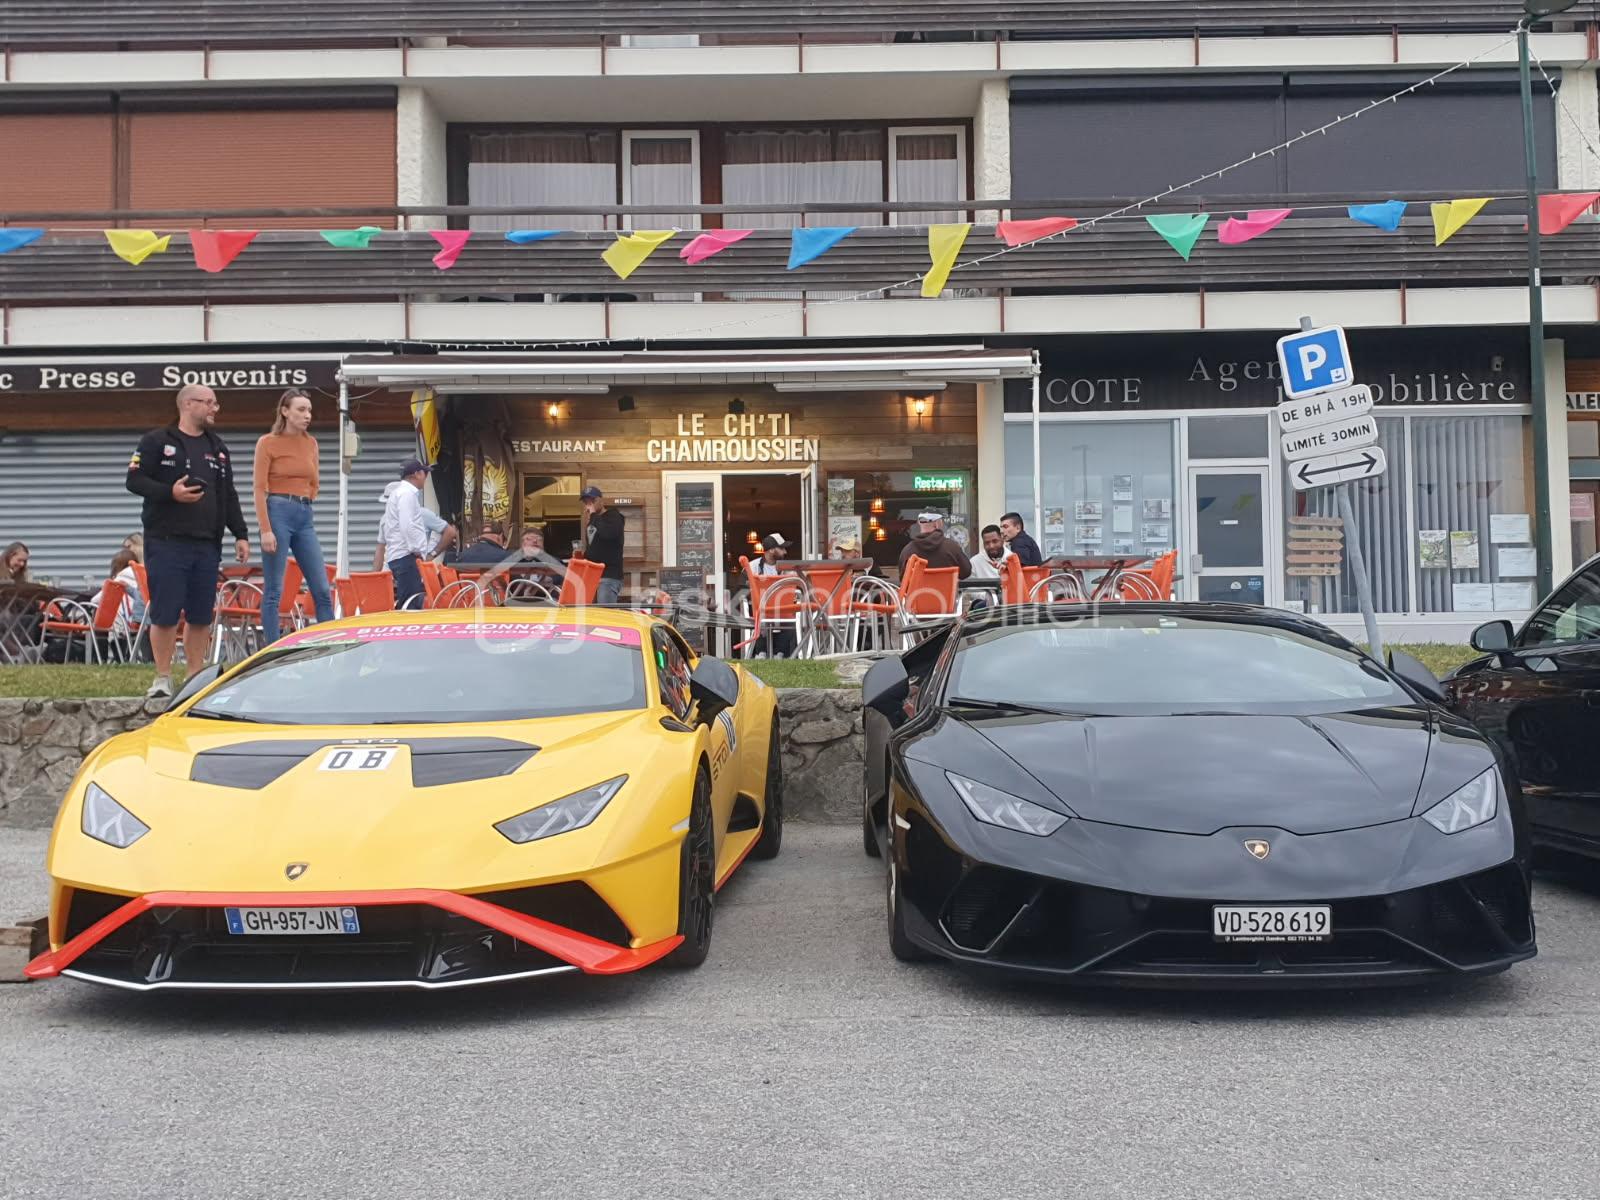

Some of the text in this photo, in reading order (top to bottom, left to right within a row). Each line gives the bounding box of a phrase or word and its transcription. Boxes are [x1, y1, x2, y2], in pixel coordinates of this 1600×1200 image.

[1298, 344, 1327, 382] P
[39, 367, 136, 389] Presse
[163, 365, 307, 387] Souvenirs
[1045, 378, 1142, 405] COTE
[1282, 393, 1367, 422] DE 8H À 19H
[677, 413, 790, 437] LE CH'TI
[511, 440, 607, 453] ESTAURANT
[647, 438, 819, 463] CHAMROUSSIEN
[1286, 424, 1371, 453] LIMITÉ 30MIN
[914, 476, 963, 489] Restaurant
[245, 910, 339, 931] GH-957-JN
[345, 922, 356, 931] 73
